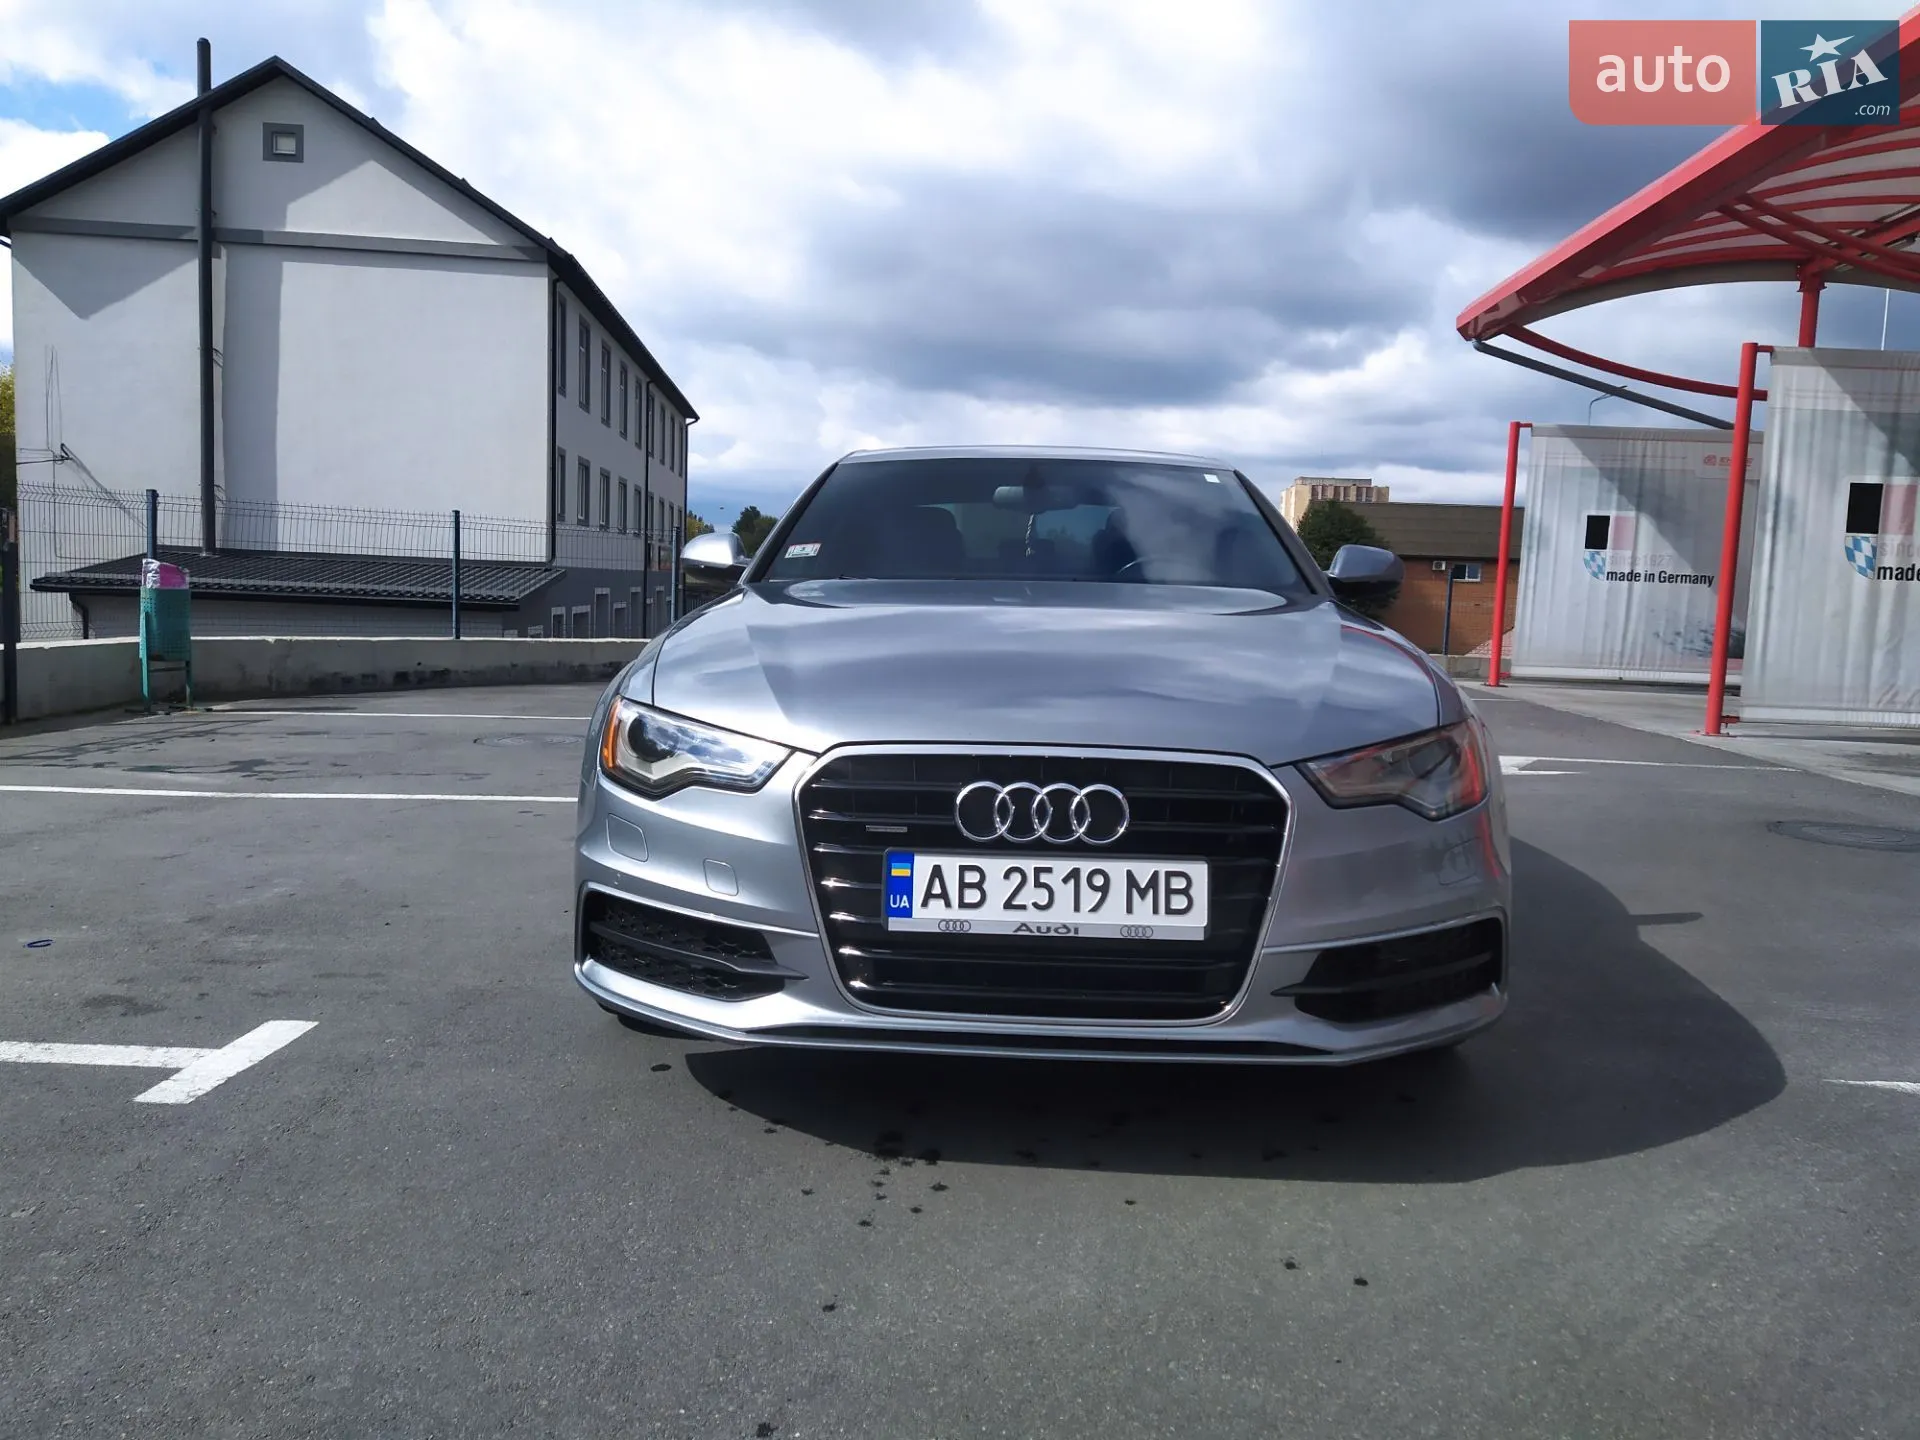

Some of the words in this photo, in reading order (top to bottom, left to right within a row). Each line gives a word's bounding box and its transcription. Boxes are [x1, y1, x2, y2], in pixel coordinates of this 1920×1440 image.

[1606, 569, 1641, 582] made
[1644, 570, 1655, 583] in
[1658, 570, 1715, 588] Germany
[920, 864, 988, 910] AB
[1002, 865, 1111, 914] 2519
[1125, 868, 1195, 916] MB
[890, 894, 910, 909] UA
[1012, 922, 1079, 935] Audi
